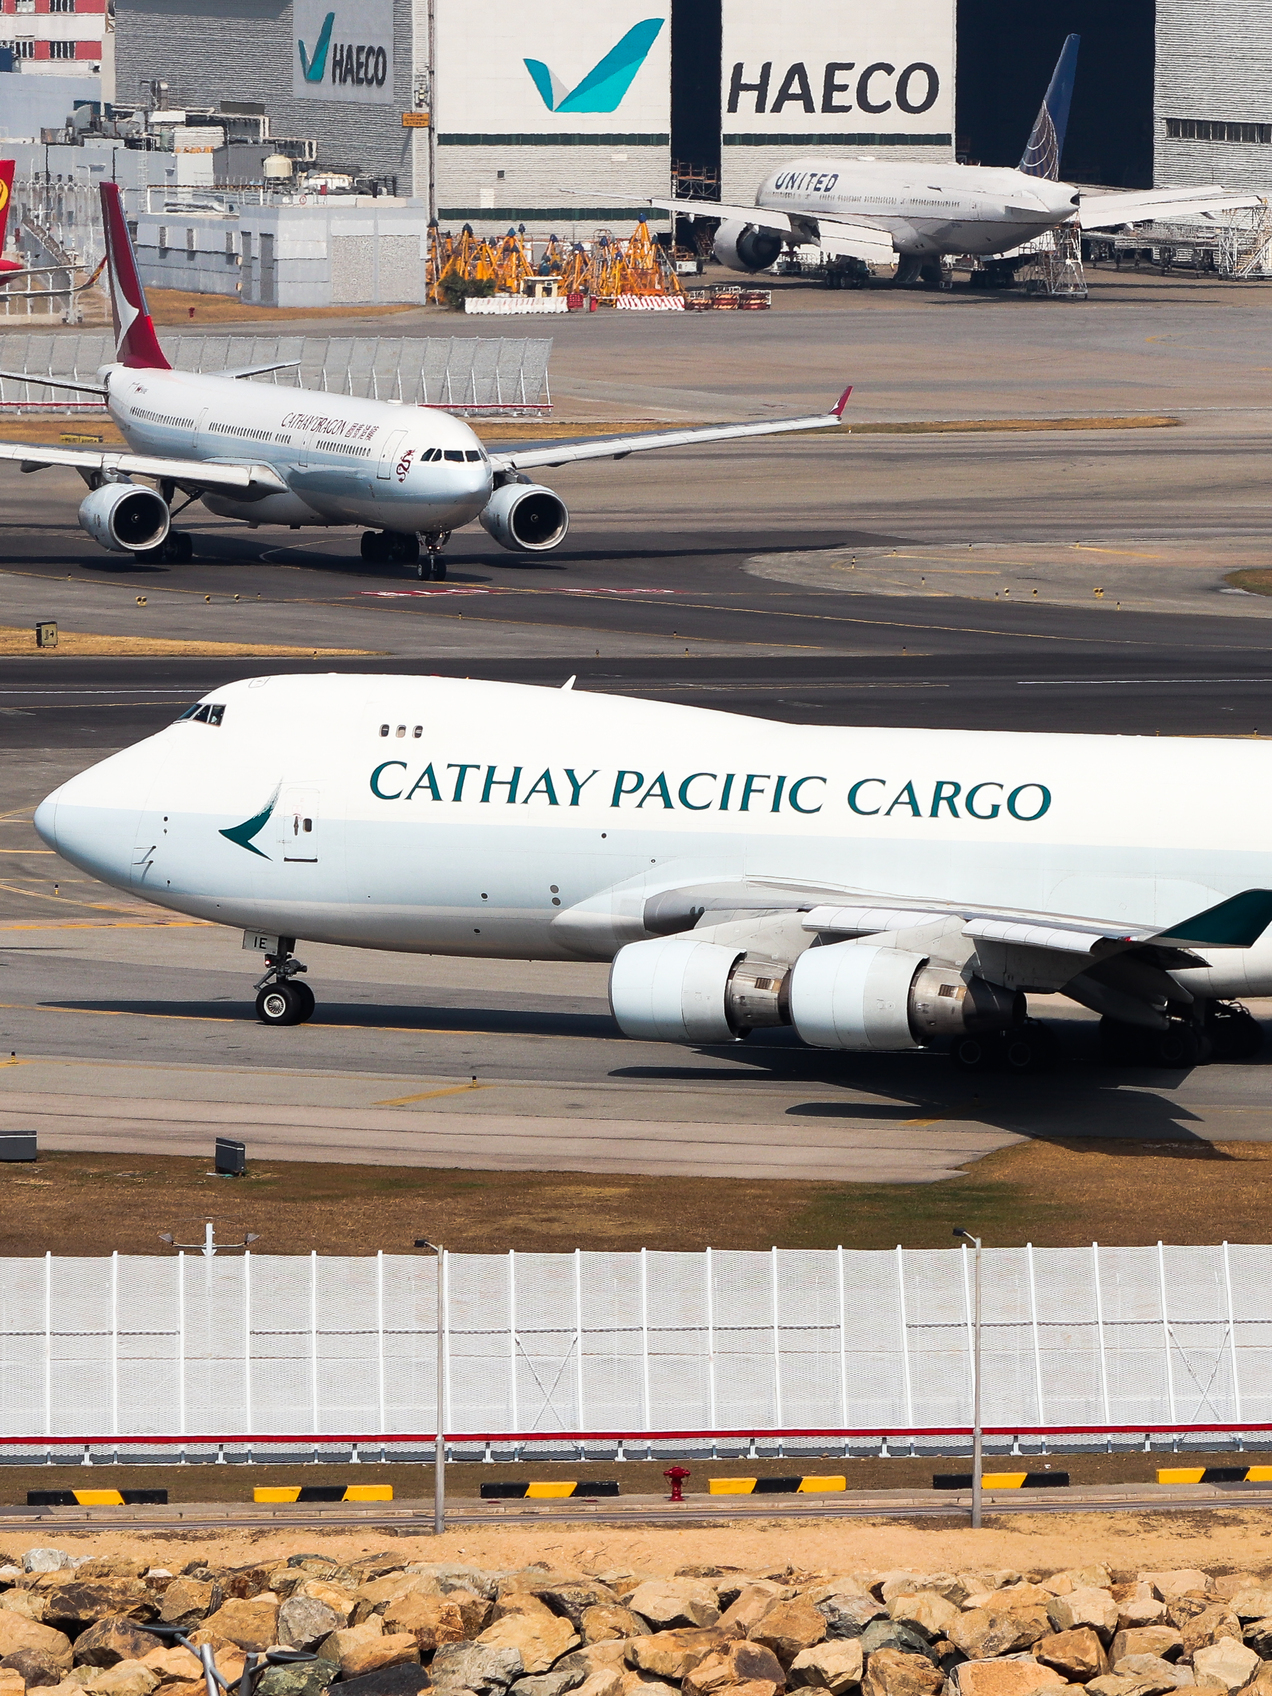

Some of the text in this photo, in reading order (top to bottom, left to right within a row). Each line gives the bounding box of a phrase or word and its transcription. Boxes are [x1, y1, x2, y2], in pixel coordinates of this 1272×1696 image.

[332, 43, 387, 86] HAECO
[726, 61, 940, 114] HAECO
[774, 171, 840, 193] UNITED
[370, 760, 1052, 822] CATHAY PACIFIC CARGO
[253, 936, 268, 950] IE
